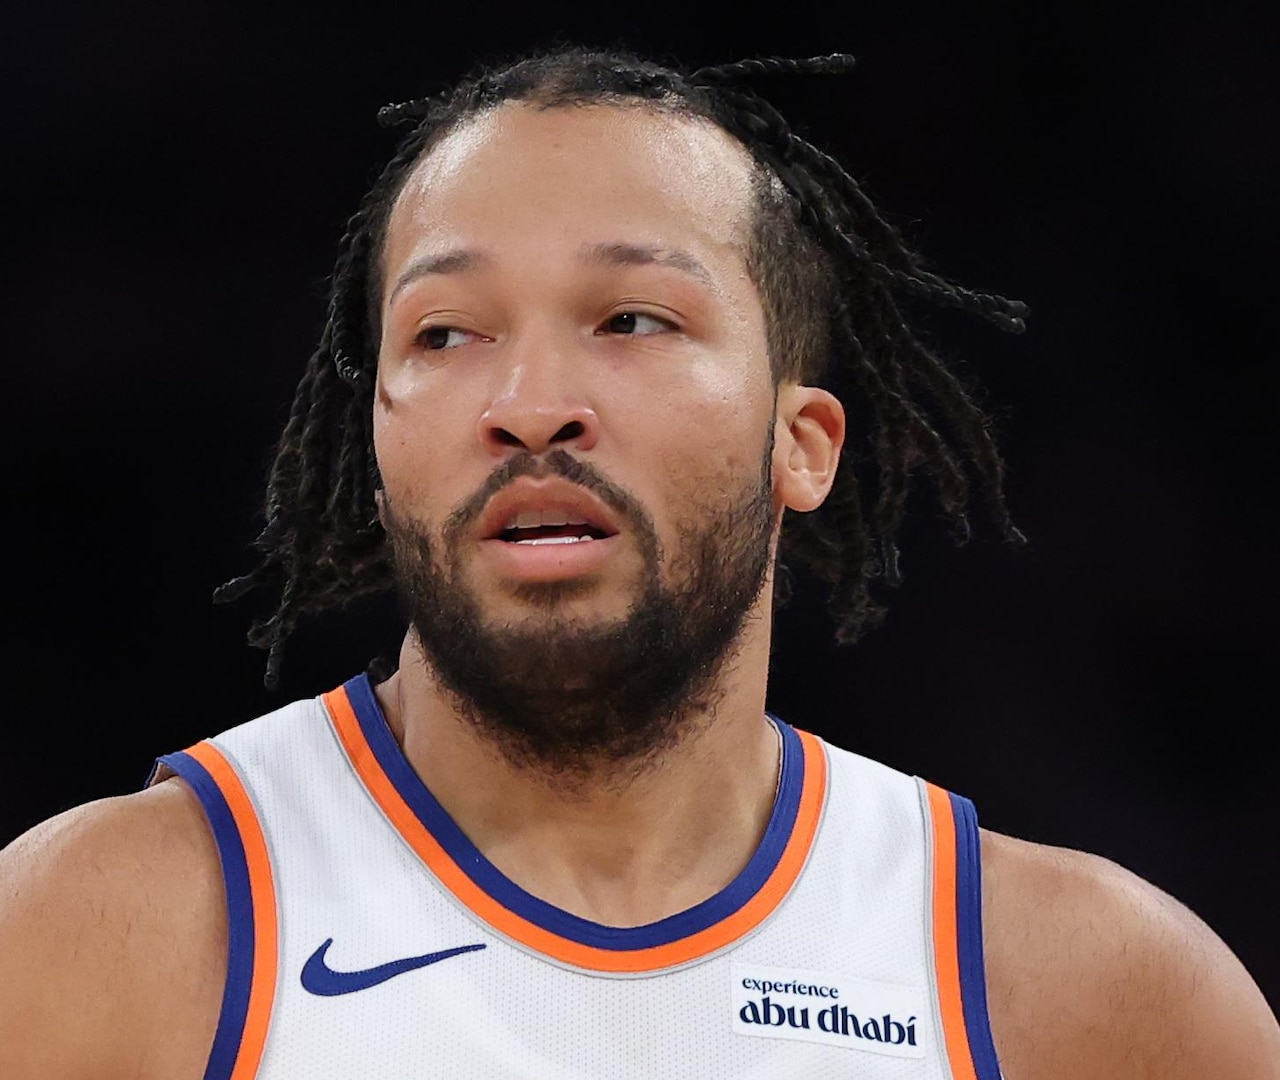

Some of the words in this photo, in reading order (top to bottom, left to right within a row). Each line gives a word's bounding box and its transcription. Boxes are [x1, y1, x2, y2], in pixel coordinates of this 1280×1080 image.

[742, 977, 839, 999] experience
[739, 996, 811, 1029] abu
[817, 1004, 918, 1046] dhabi
